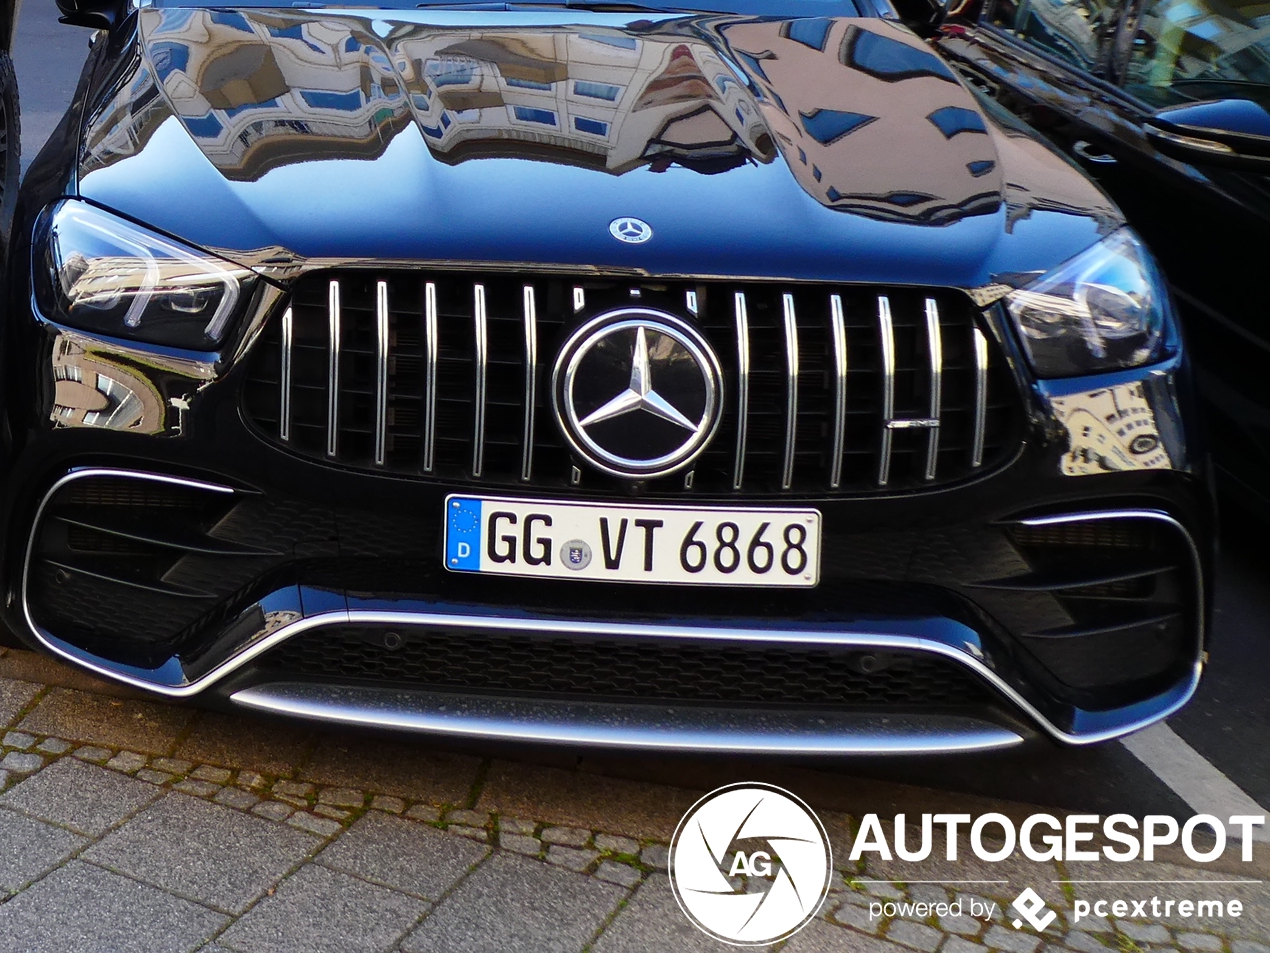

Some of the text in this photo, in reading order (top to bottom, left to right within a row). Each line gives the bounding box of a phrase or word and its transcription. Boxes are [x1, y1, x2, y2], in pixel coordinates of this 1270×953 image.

[457, 542, 471, 558] D
[486, 510, 808, 576] GG VT 6868
